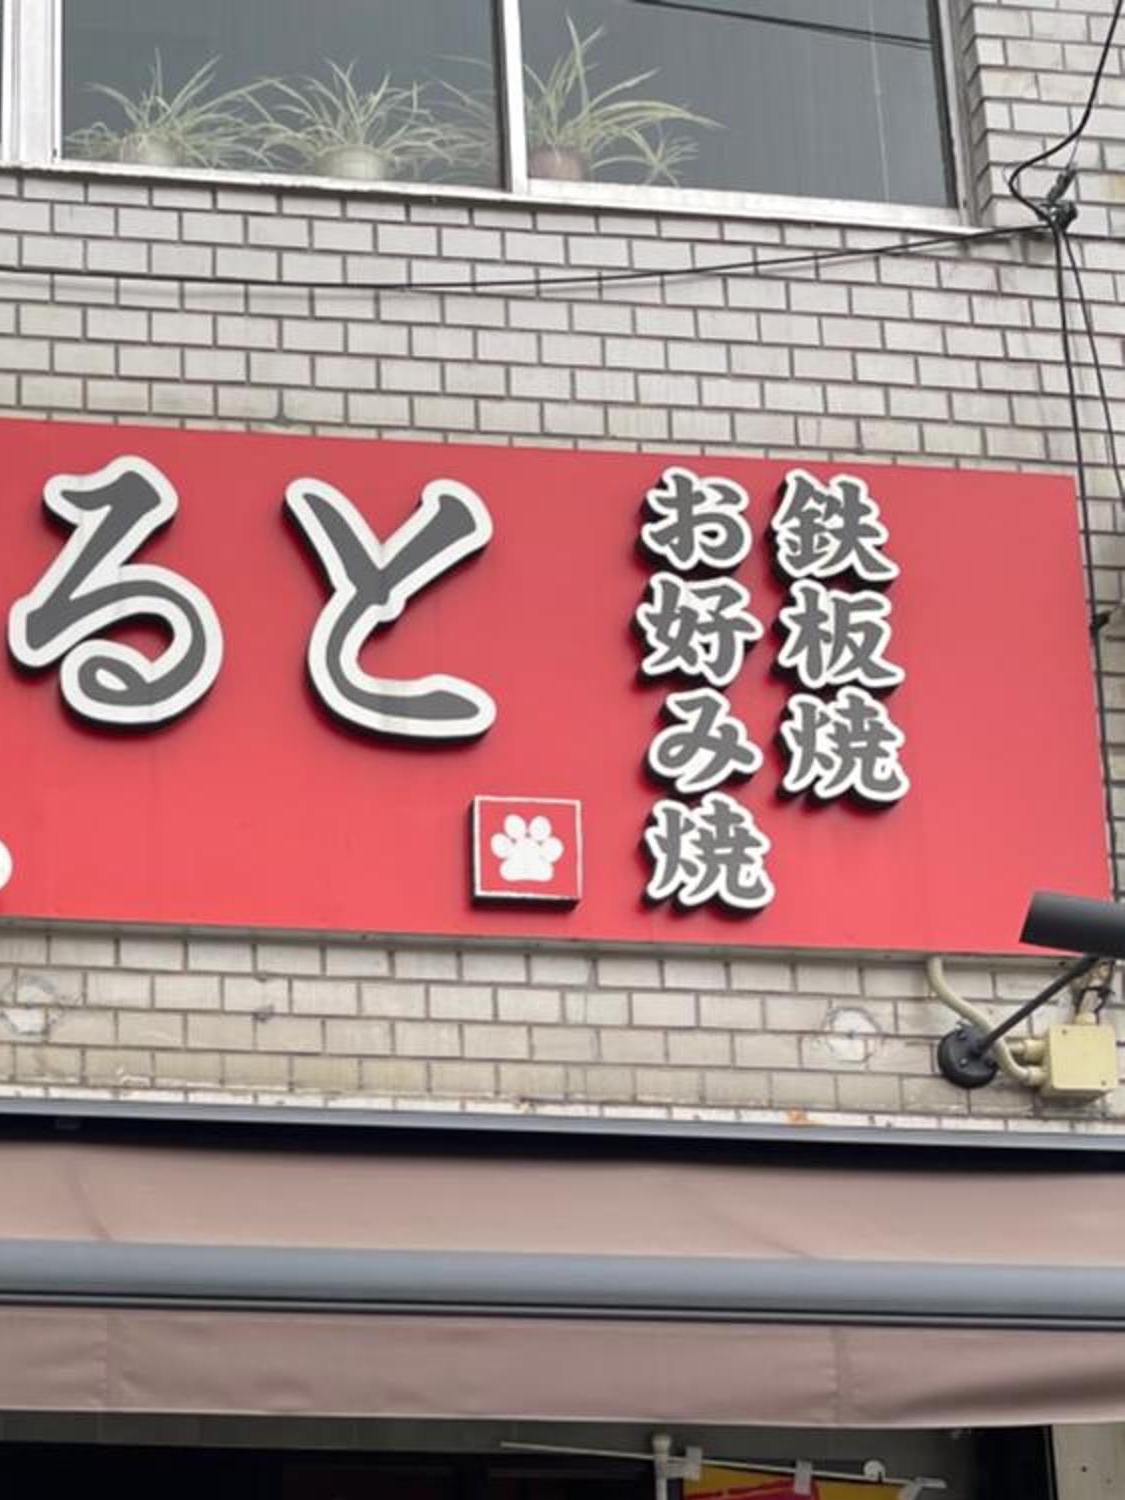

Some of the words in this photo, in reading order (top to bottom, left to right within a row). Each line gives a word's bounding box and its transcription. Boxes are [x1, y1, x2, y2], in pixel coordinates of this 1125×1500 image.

[635, 466, 776, 908] お好み焼
[770, 468, 910, 803] 鉄板焼
